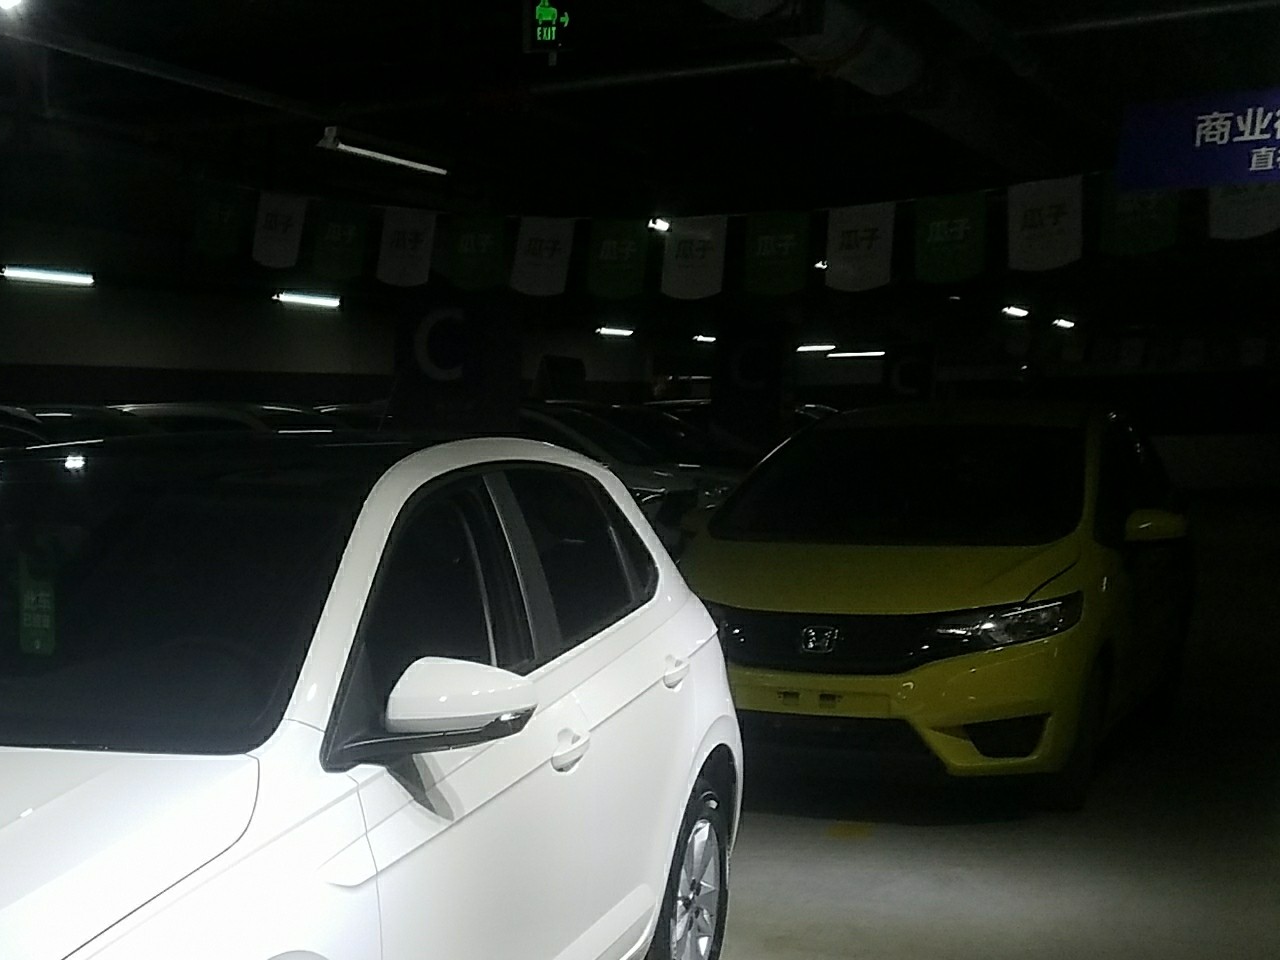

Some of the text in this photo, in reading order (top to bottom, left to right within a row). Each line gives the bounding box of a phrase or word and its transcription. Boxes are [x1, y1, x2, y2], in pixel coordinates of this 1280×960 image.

[535, 26, 557, 40] EXIT
[1194, 106, 1280, 148] 商业
[413, 302, 465, 381] C
